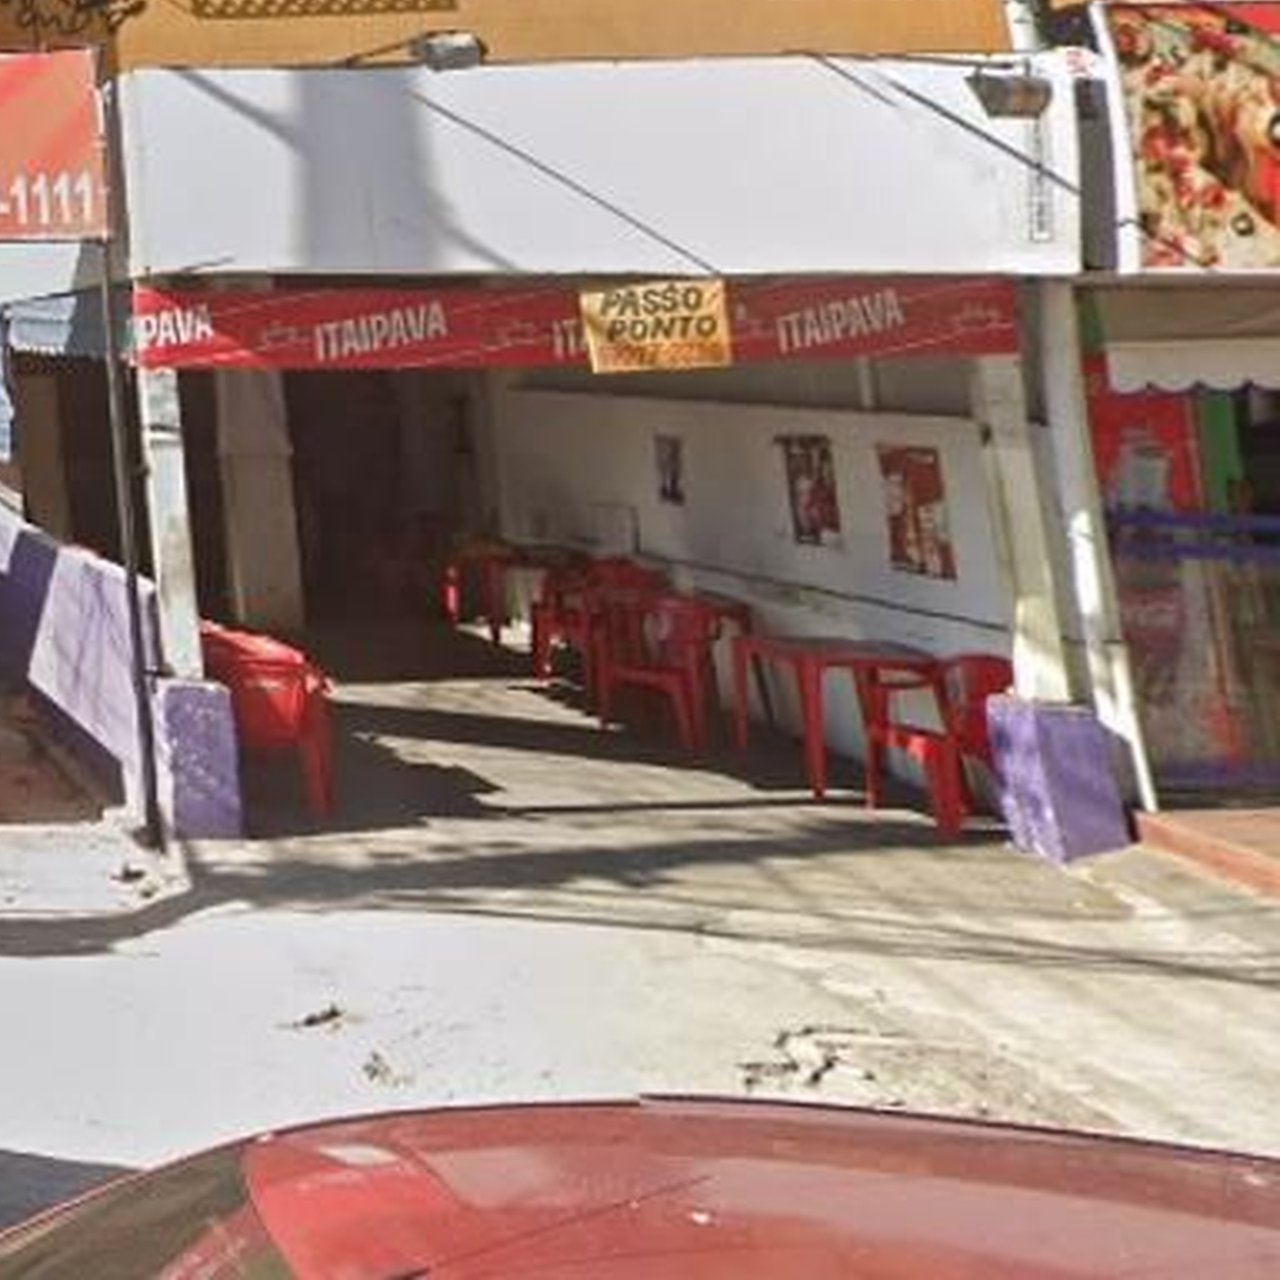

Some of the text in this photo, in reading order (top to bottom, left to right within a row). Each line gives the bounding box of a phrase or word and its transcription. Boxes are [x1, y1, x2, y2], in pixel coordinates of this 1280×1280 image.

[314, 299, 448, 362] ITAIPAVA
[607, 315, 717, 342] PONTO
[776, 287, 905, 352] ITAIPAVA
